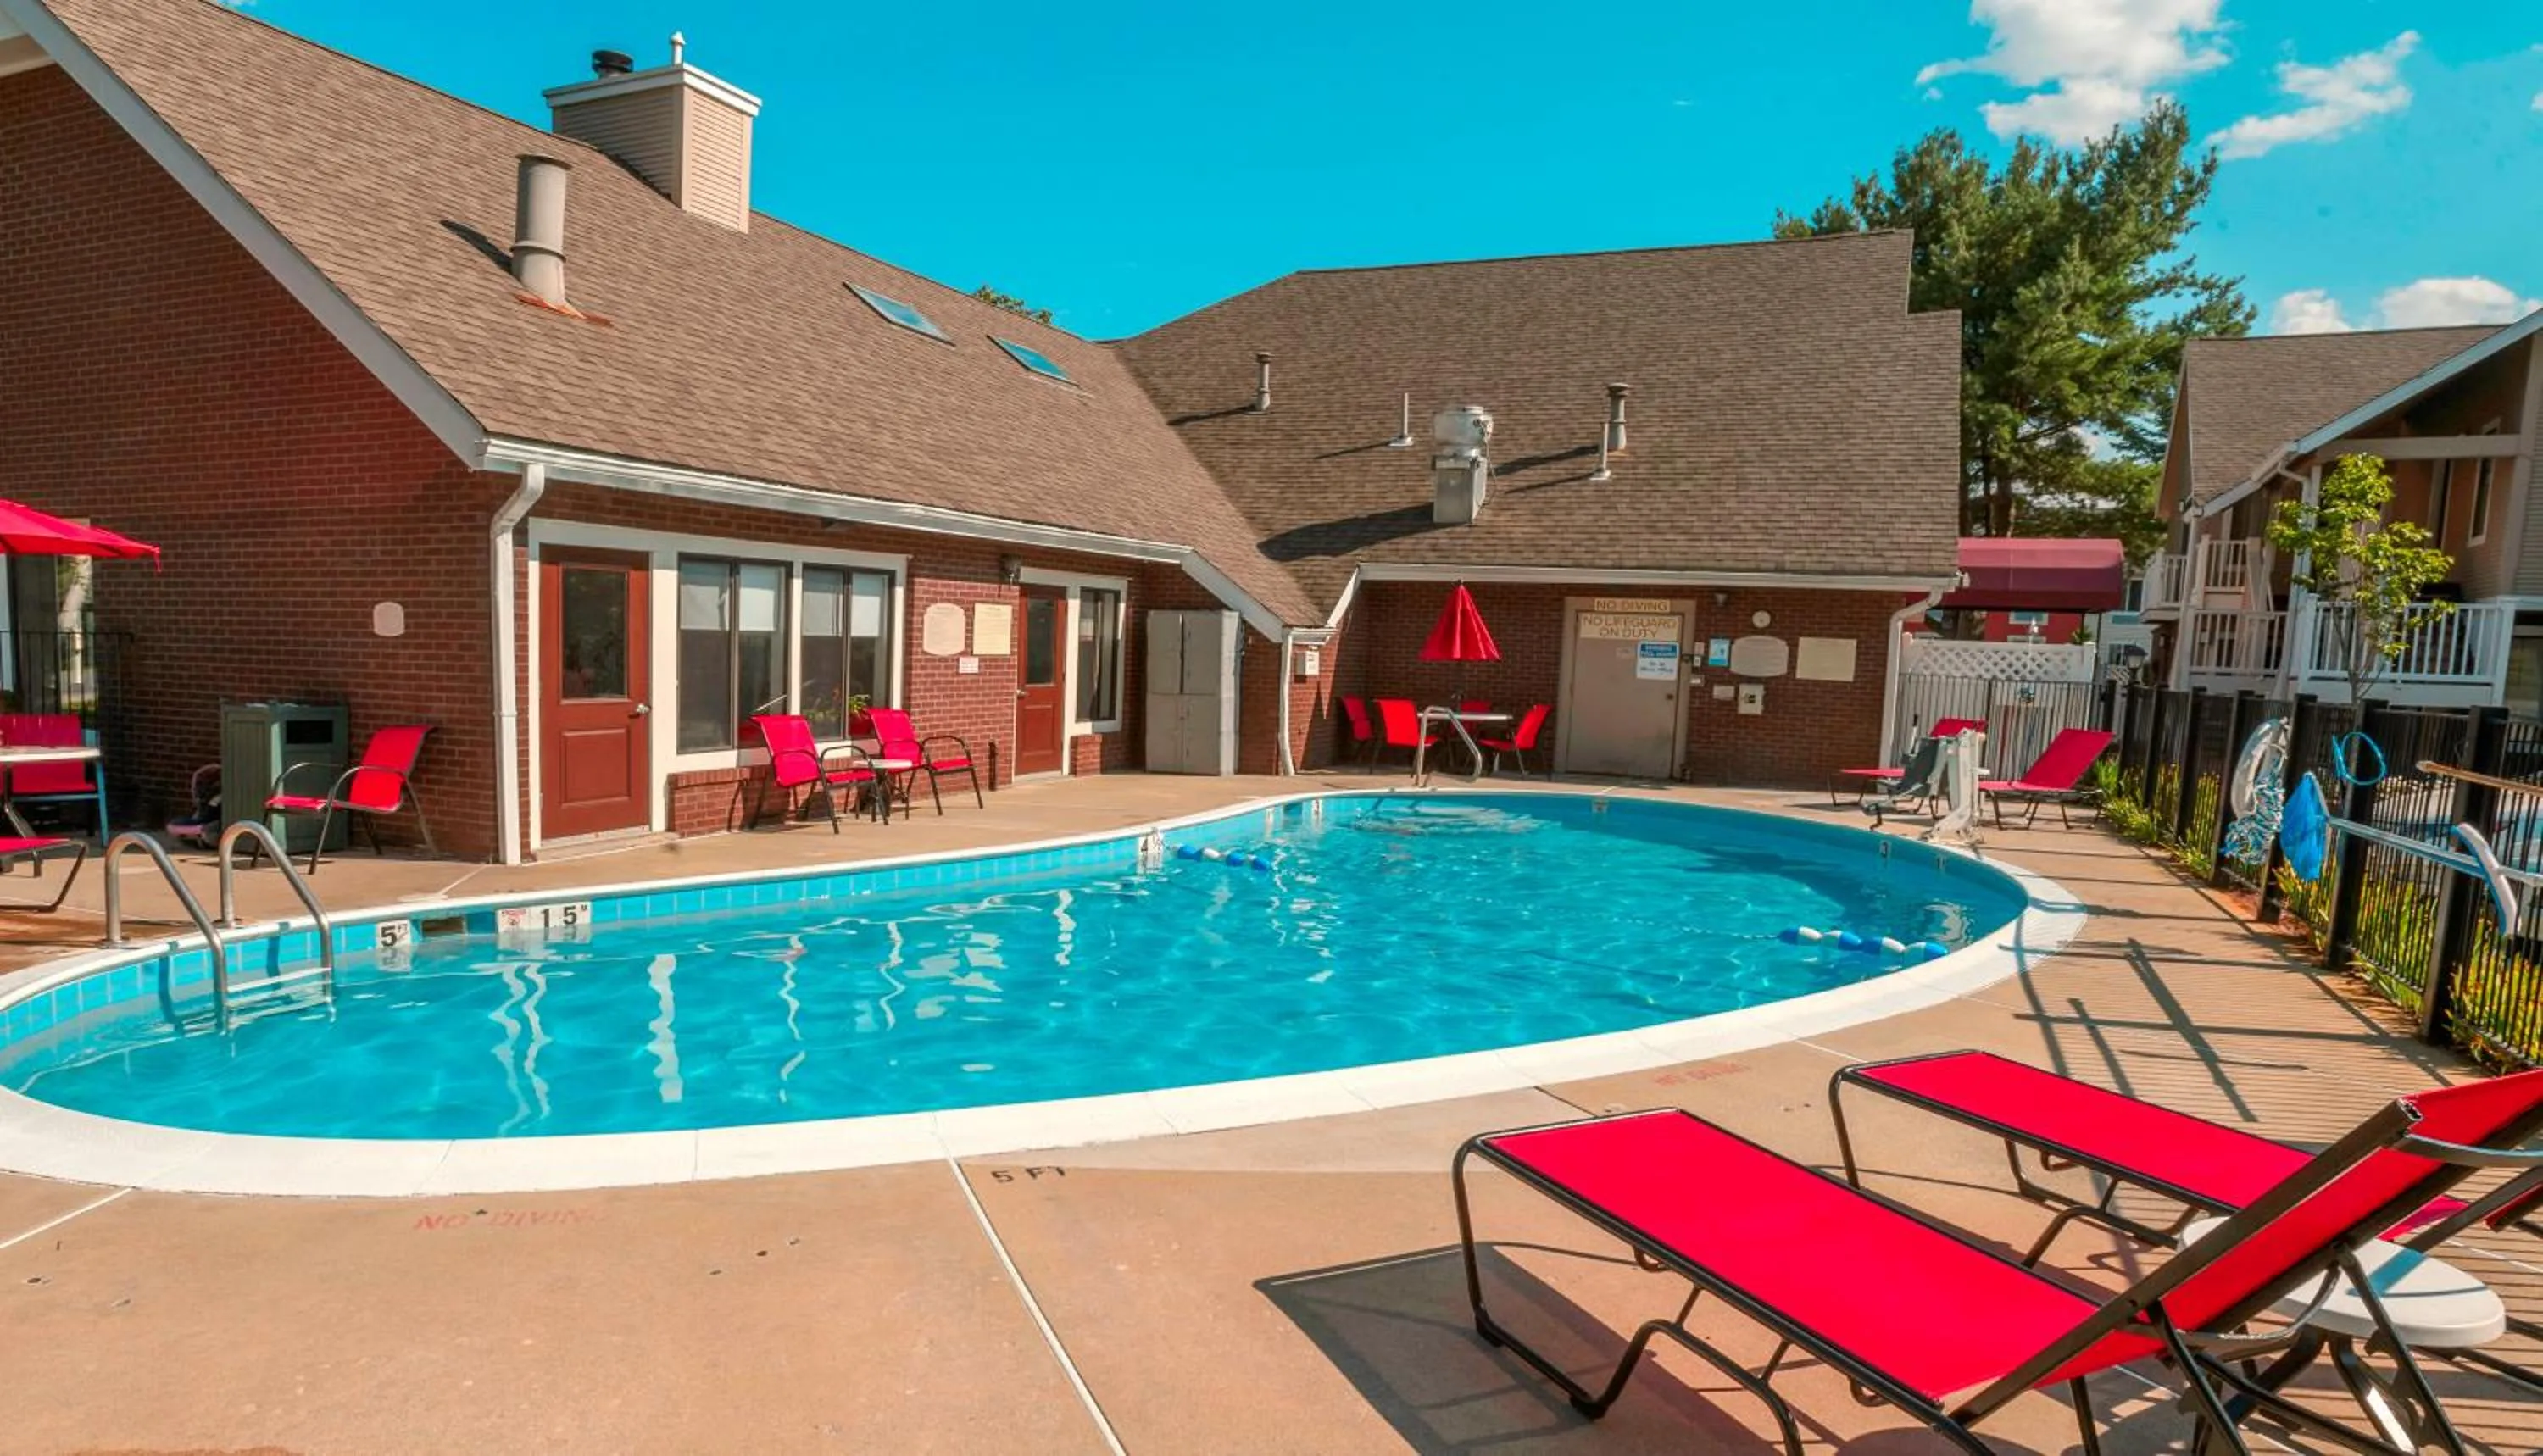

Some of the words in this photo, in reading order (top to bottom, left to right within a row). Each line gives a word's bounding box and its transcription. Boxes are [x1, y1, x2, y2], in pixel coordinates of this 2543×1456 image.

[1596, 600, 1616, 609] NO
[1622, 601, 1667, 610] DIVING
[1583, 615, 1603, 625] NO
[1600, 626, 1620, 637] ON
[1622, 628, 1657, 637] DUTY
[990, 1170, 1014, 1182] 5
[415, 1214, 470, 1229] NO
